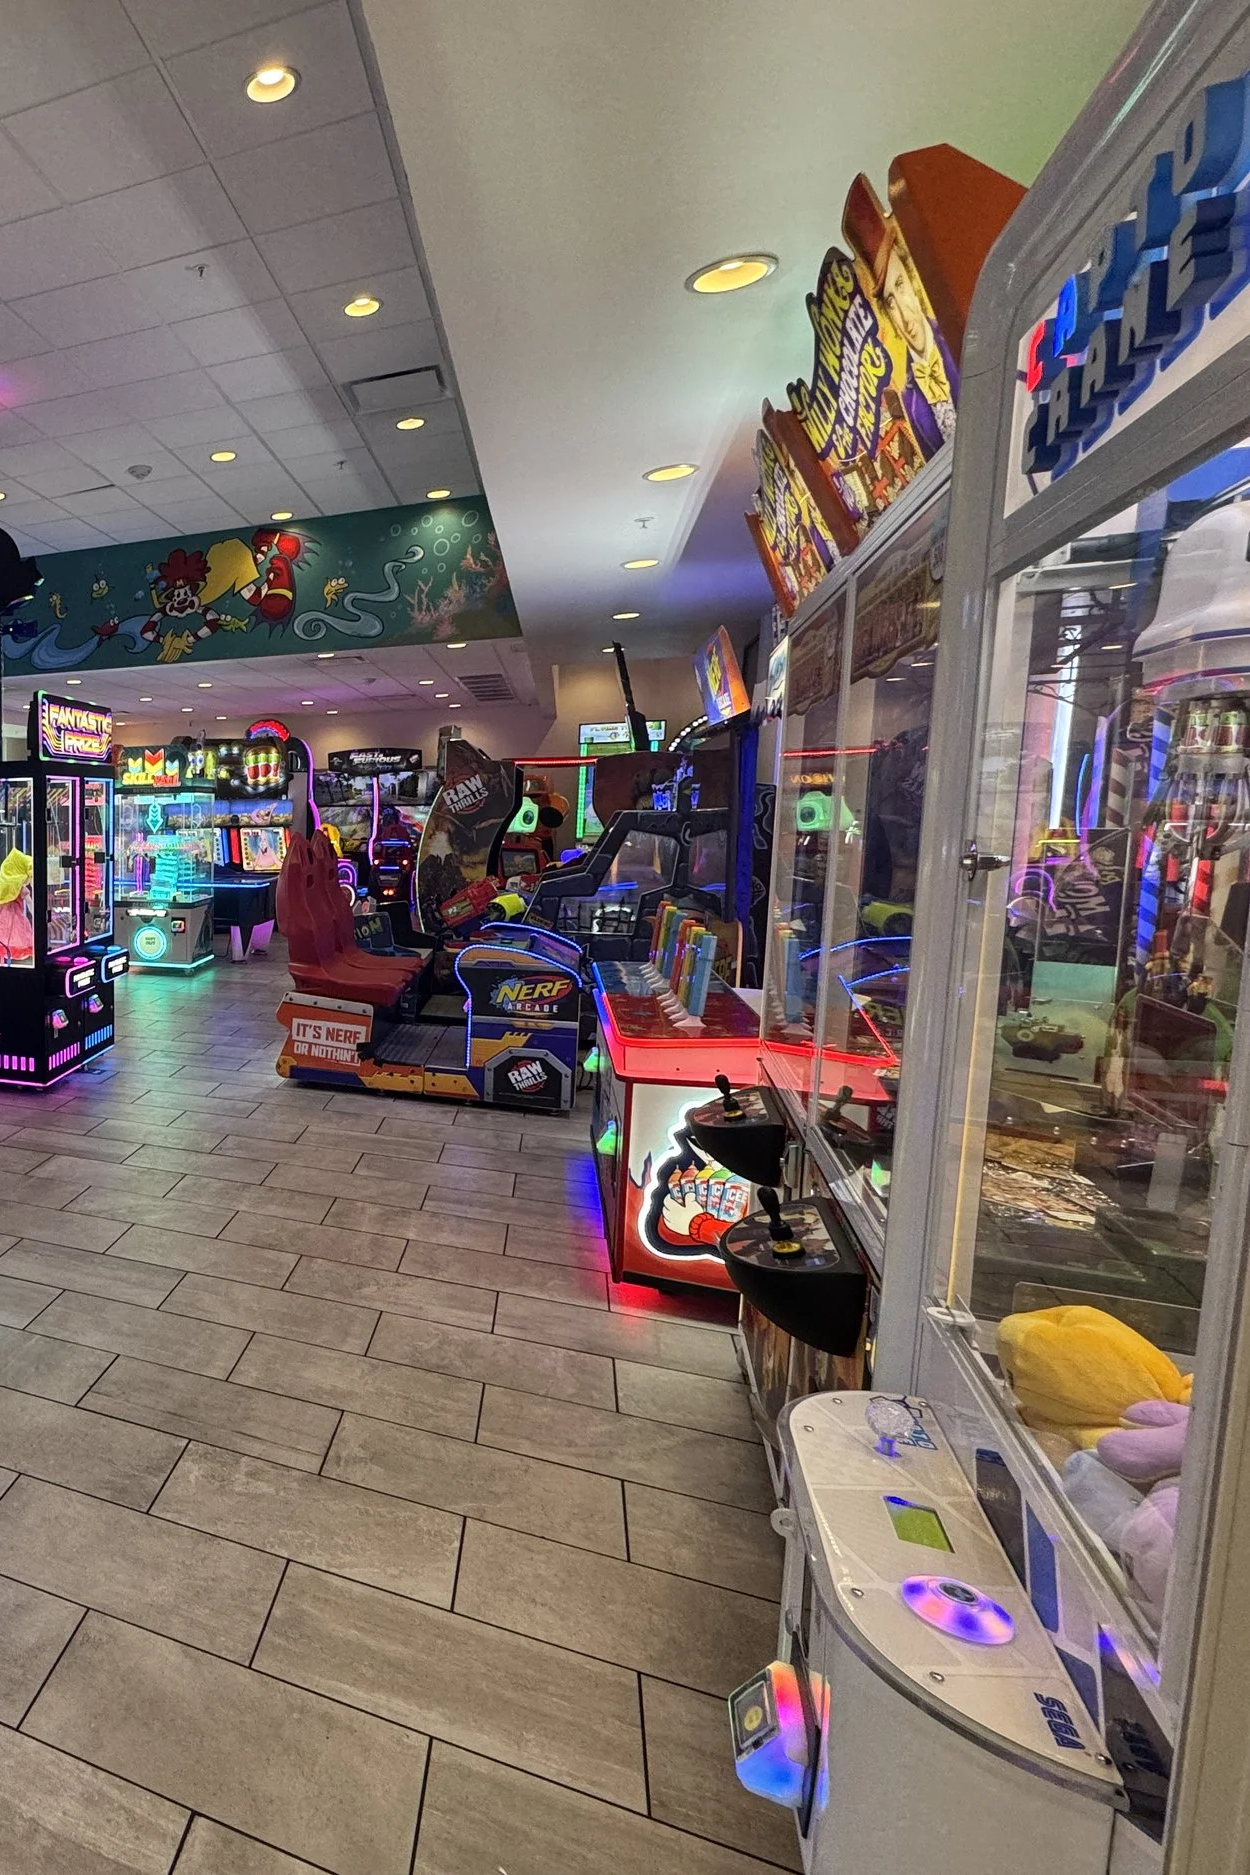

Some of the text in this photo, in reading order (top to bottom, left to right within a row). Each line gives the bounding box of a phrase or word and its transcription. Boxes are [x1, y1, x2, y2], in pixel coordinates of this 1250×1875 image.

[838, 294, 874, 428] CHOCOLATE
[856, 335, 886, 451] FACTORY
[50, 704, 112, 733] FANTASTIC
[62, 732, 102, 755] PRIZE
[349, 751, 379, 760] FAST
[352, 755, 402, 766] FURIOUS
[442, 773, 485, 806] RAW
[448, 787, 490, 815] THRILLS
[498, 978, 571, 1003] NERF
[507, 1002, 560, 1014] ARCADE
[296, 1022, 362, 1045] IT'S NERF
[293, 1041, 309, 1056] OR
[507, 1060, 543, 1083] RAW
[513, 1072, 548, 1090] THRILLS
[726, 1189, 748, 1202] ICEE
[1033, 1692, 1087, 1750] SEGA
